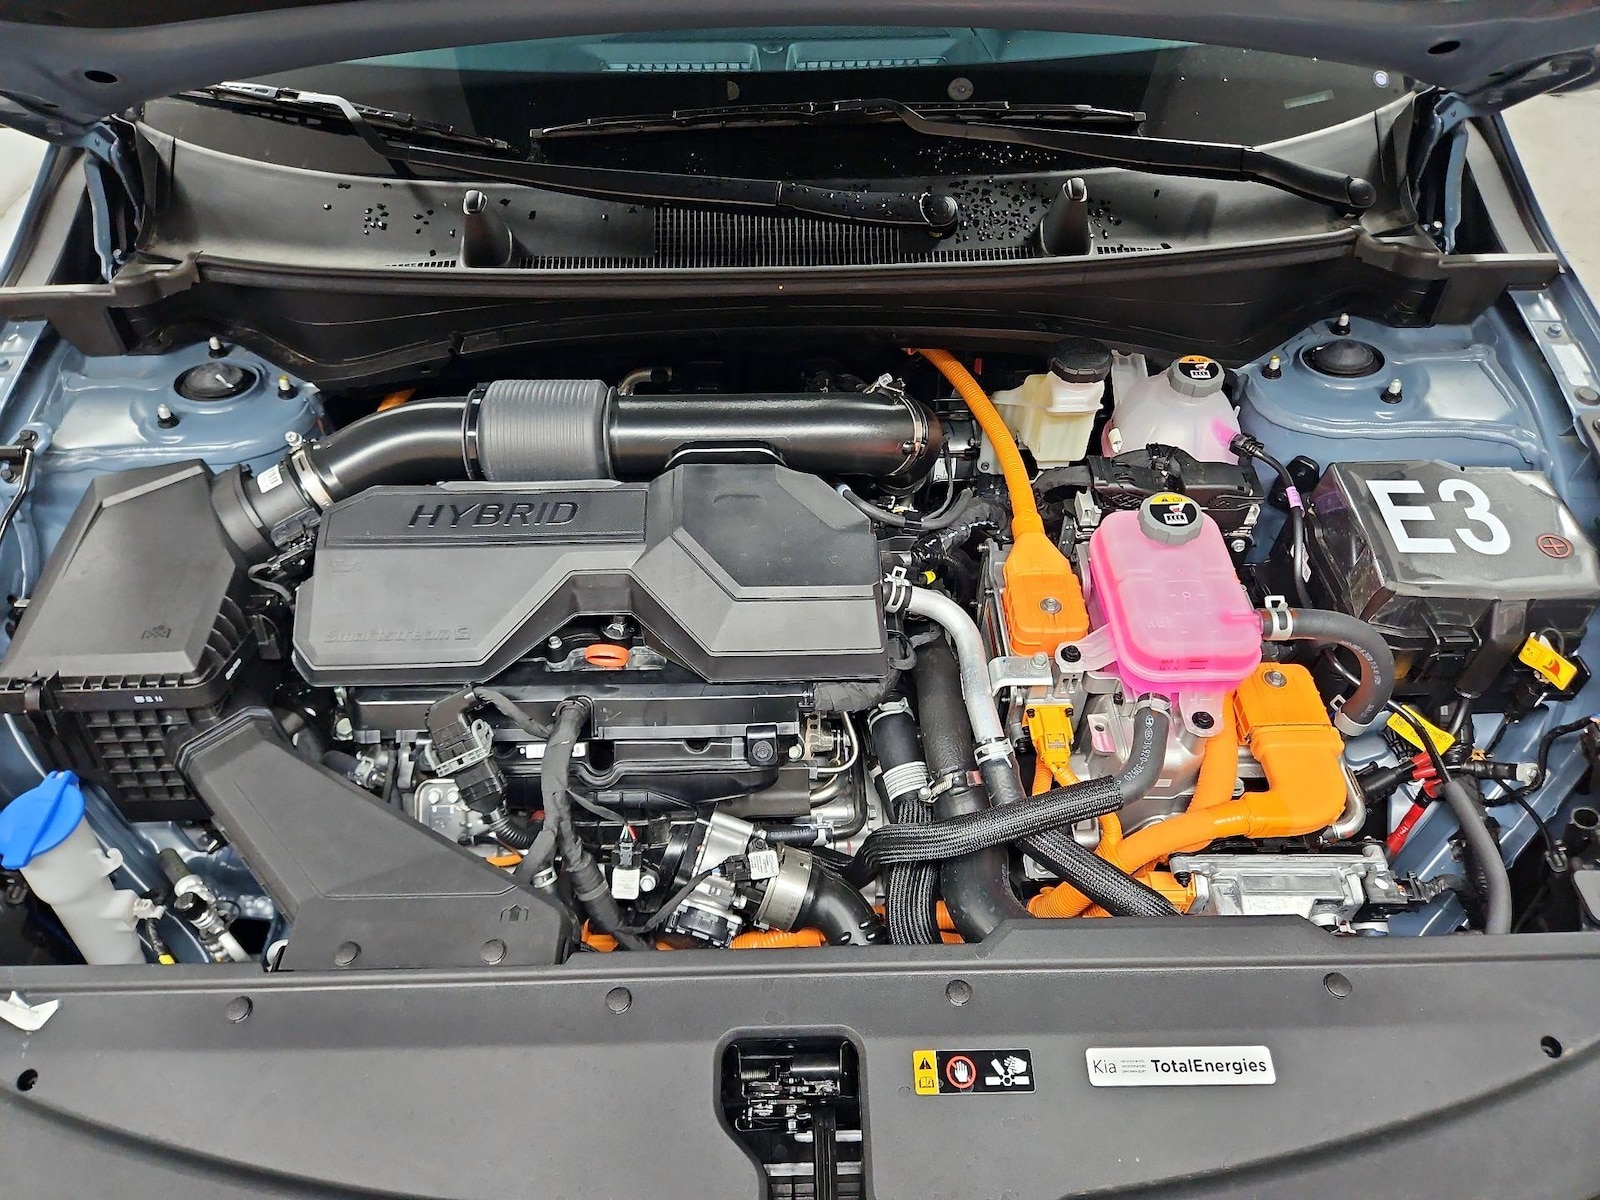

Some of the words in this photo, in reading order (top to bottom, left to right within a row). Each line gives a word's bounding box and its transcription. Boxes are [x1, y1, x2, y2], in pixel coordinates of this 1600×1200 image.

[408, 502, 579, 528] HYBRID
[1366, 479, 1511, 555] E3
[323, 628, 450, 643] Smartstream
[1092, 1059, 1117, 1074] Kia
[1150, 1058, 1267, 1075] TotalEnergies
